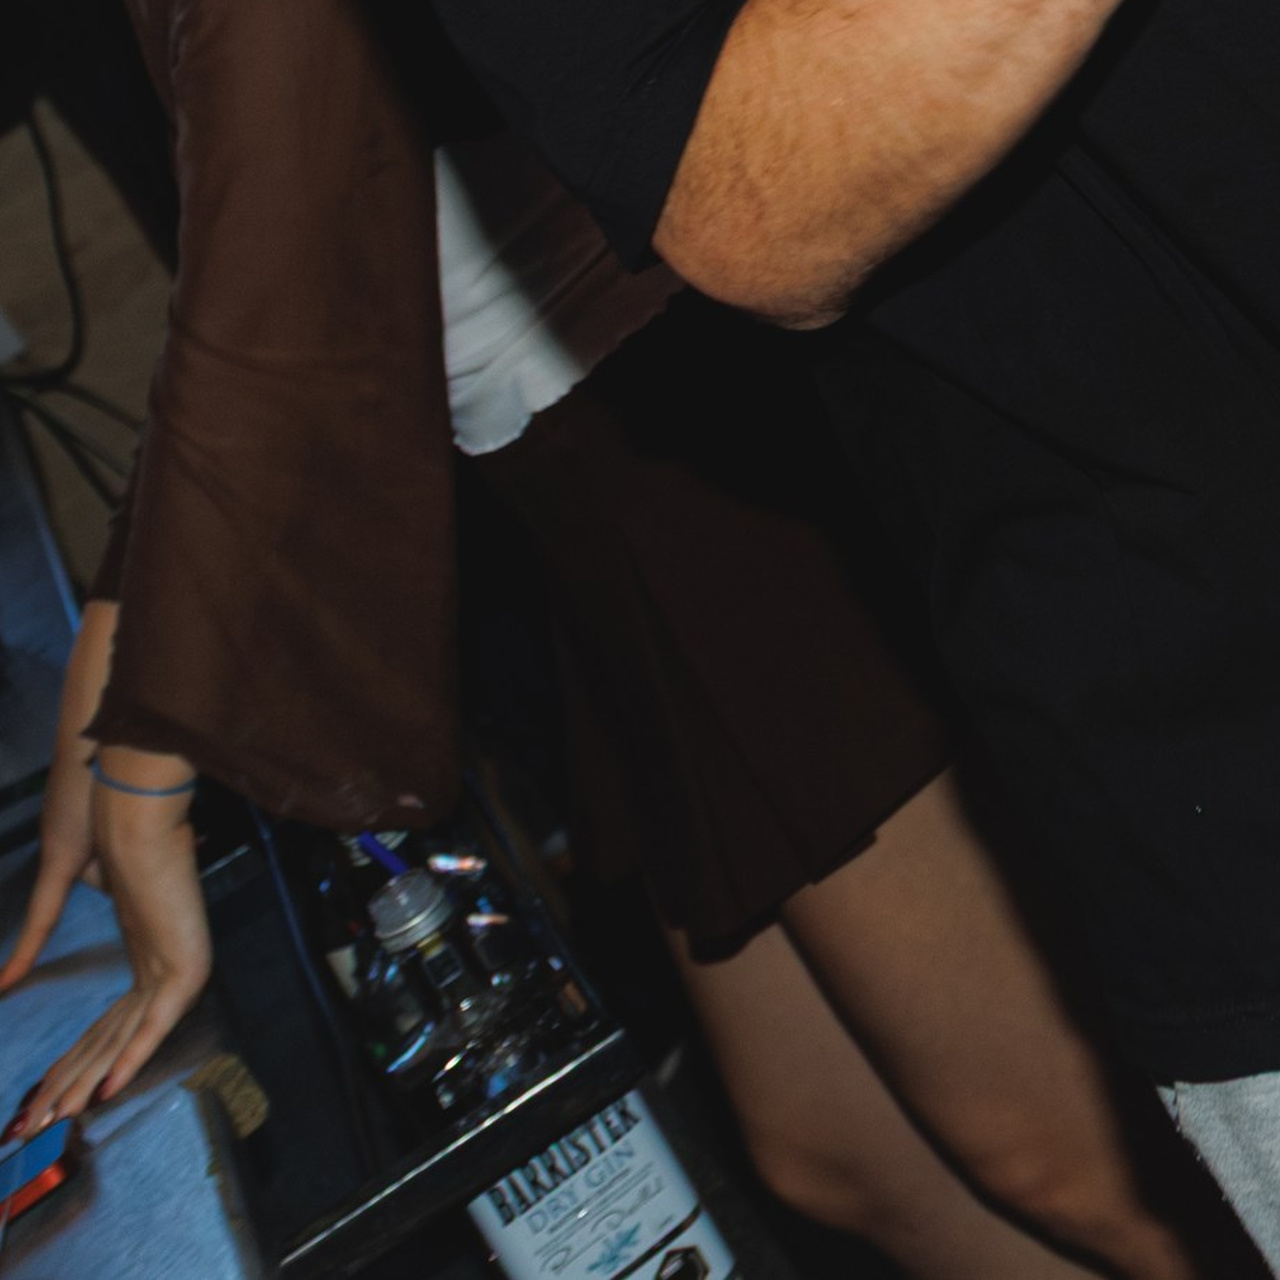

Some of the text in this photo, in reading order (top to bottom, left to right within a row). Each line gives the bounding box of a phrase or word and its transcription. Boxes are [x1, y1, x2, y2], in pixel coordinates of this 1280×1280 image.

[487, 1096, 643, 1227] BARRISTER
[523, 1190, 582, 1235] DRY
[582, 1141, 636, 1190] GIN
